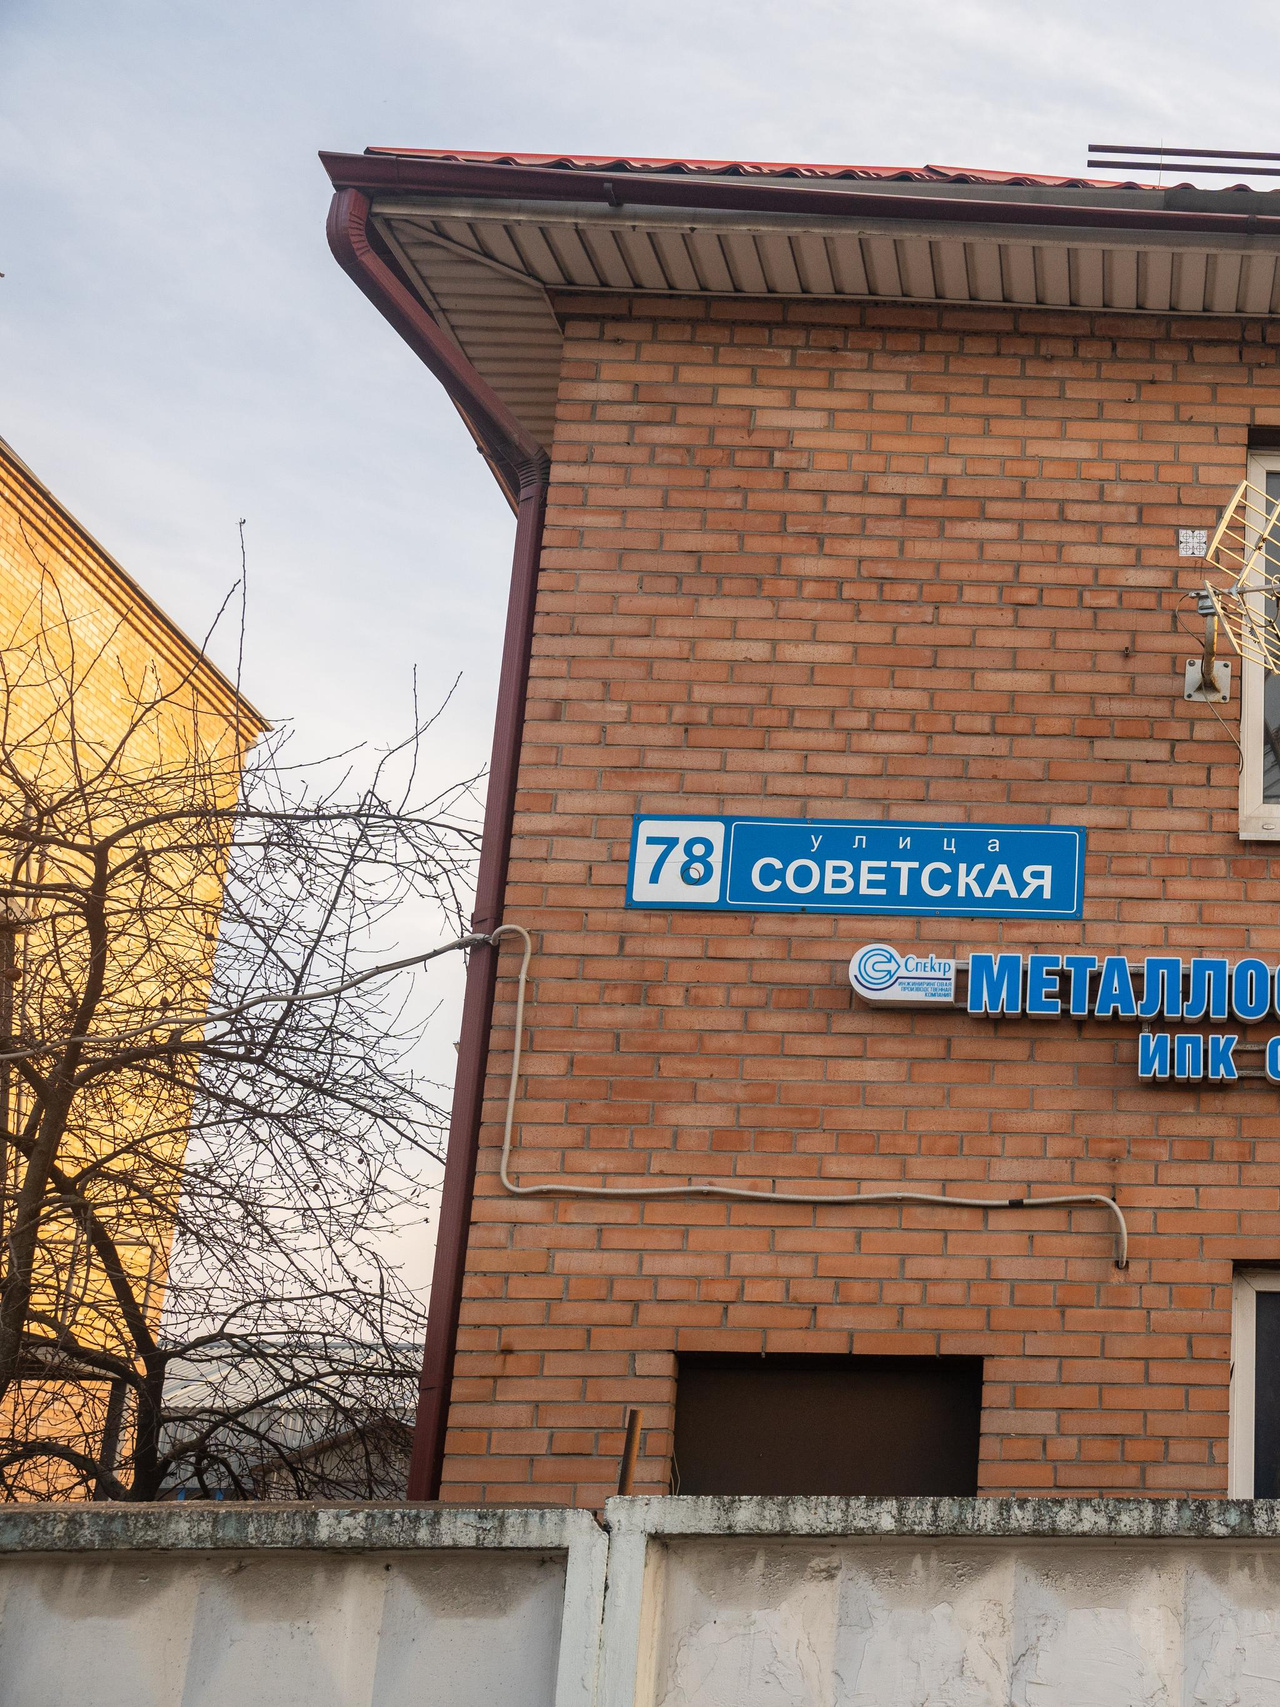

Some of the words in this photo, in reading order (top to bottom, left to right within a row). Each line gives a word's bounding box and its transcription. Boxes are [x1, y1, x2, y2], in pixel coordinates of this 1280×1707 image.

[645, 836, 714, 886] 78
[810, 833, 1001, 854] улица
[751, 857, 1053, 899] СОВЕТСКАЯ
[904, 956, 951, 976] Спектр
[1138, 1033, 1238, 1079] ИПК
